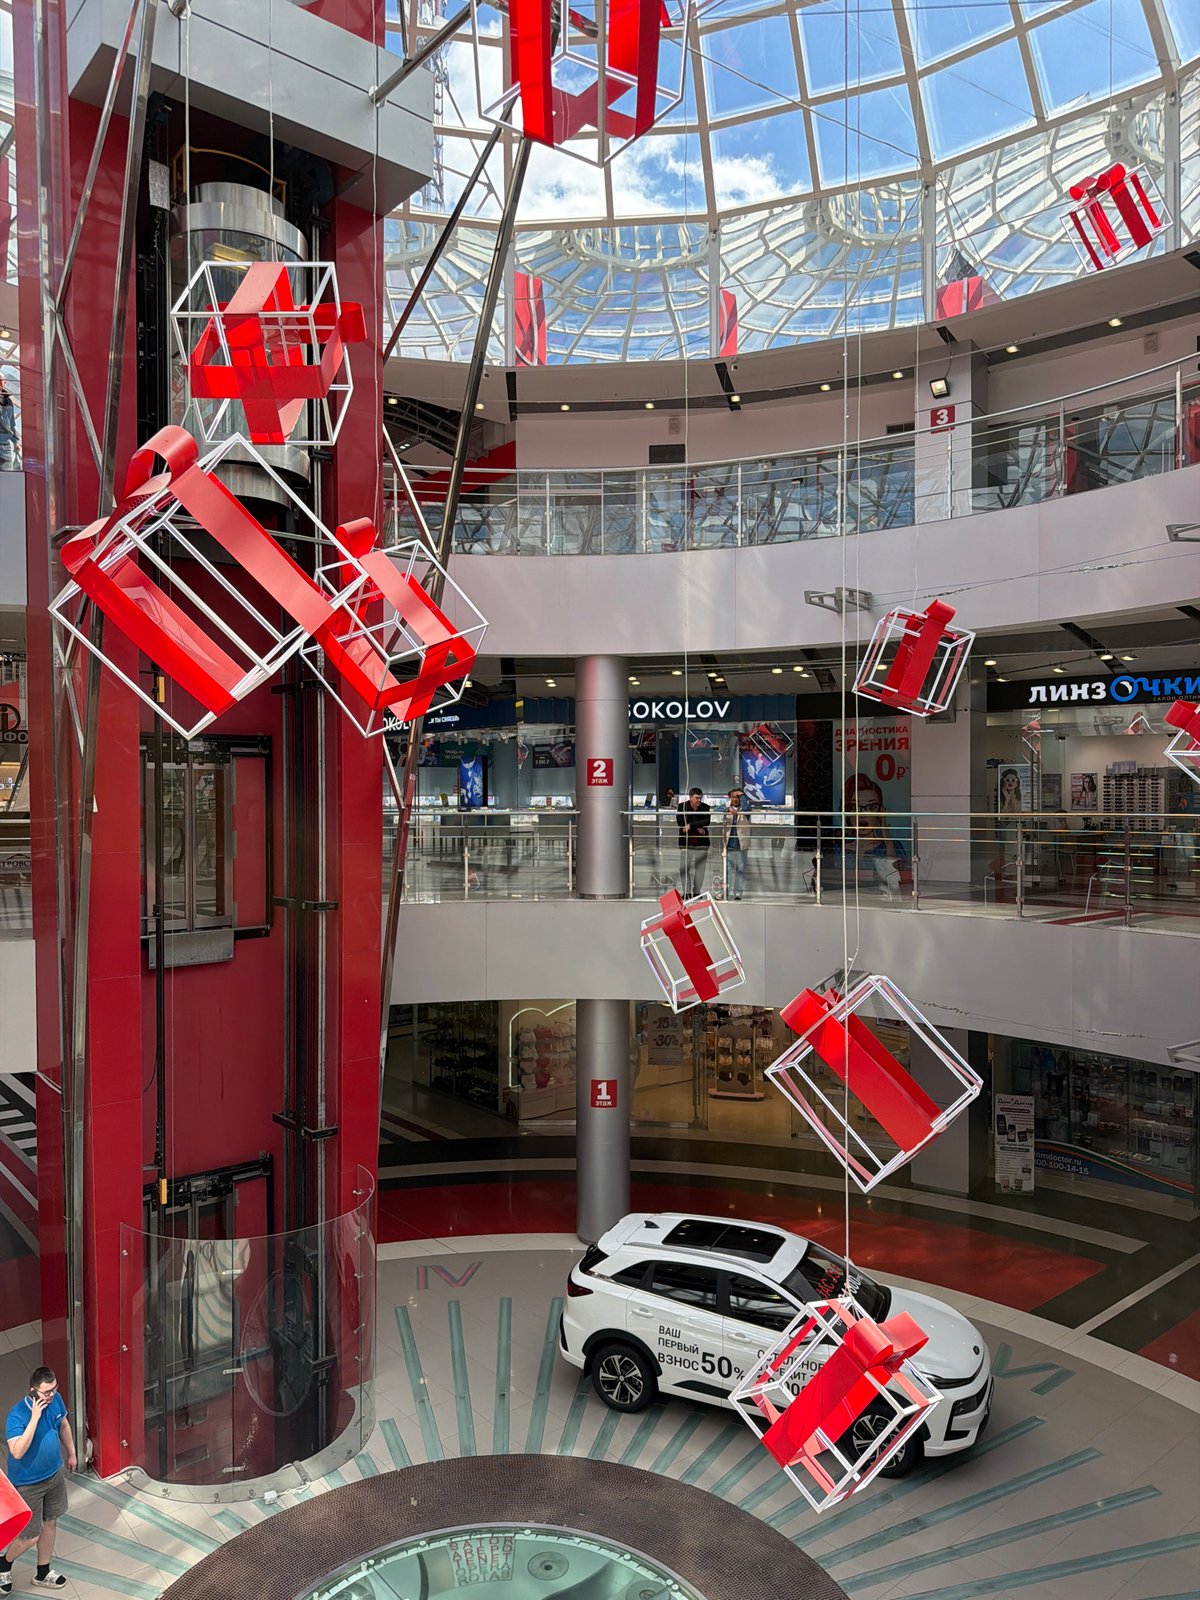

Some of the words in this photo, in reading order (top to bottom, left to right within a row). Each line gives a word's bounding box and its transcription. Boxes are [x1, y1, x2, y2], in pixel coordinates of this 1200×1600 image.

[936, 408, 949, 425] 3
[0, 731, 28, 742] ФО
[834, 726, 909, 737] ДИАГНОСТИКА
[835, 737, 909, 752] ЗРЕНИЯ
[593, 760, 606, 777] 2
[597, 1081, 611, 1100] 1
[1035, 1152, 1082, 1166] omdoctor.ru
[1035, 1159, 1089, 1175] 00-100-14-15
[658, 1325, 681, 1339] ВАШ
[658, 1337, 699, 1355] ПЕРВЫЙ
[658, 1352, 699, 1371] ВЗНОС
[449, 1536, 514, 1551] SATOR
[453, 1544, 513, 1561] AREPO
[458, 1569, 510, 1586] ROTAS
